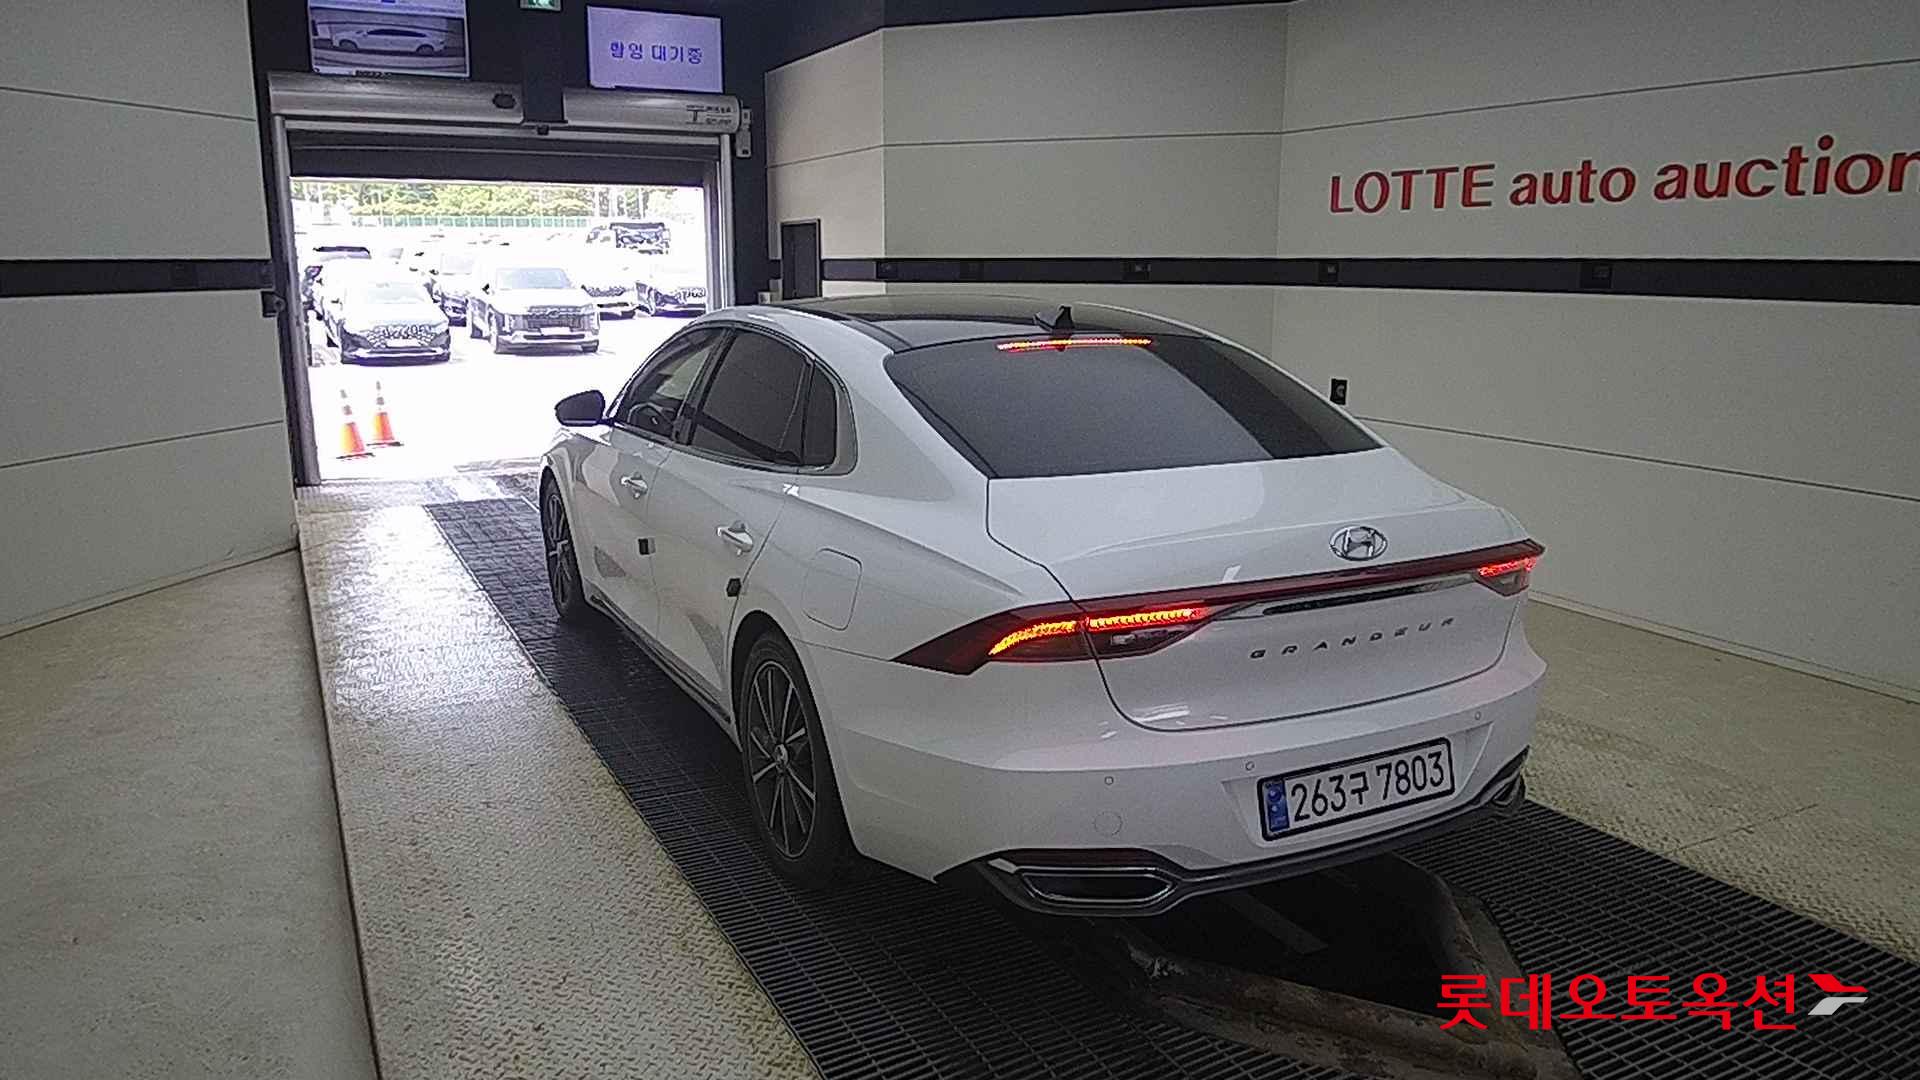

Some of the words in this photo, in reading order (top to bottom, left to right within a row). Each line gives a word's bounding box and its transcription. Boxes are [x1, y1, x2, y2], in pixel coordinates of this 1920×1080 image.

[651, 44, 702, 65] 대기중
[1331, 164, 1495, 213] LOTTE
[1511, 160, 1634, 204] auto
[1249, 617, 1455, 659] GRANDEUR
[1291, 771, 1369, 821] 263구
[1376, 751, 1444, 800] 7803
